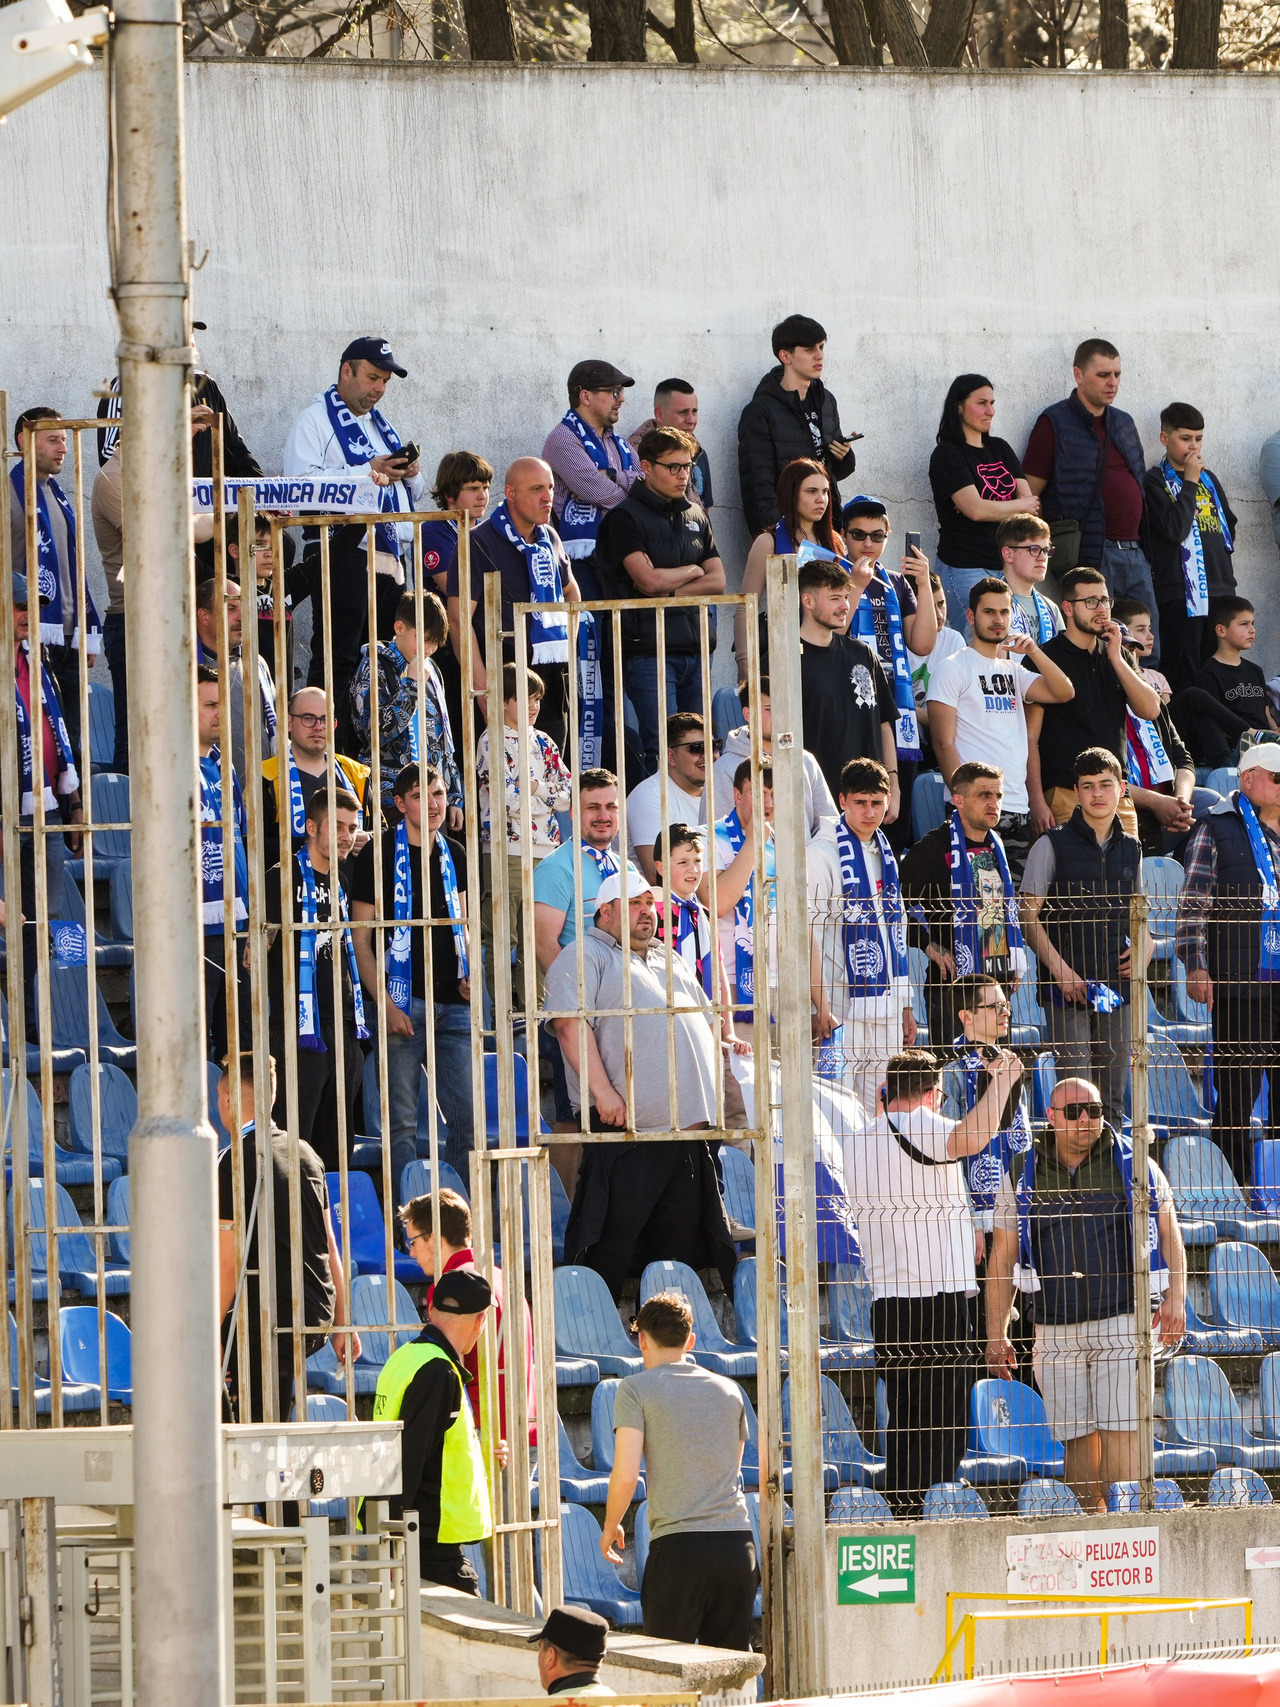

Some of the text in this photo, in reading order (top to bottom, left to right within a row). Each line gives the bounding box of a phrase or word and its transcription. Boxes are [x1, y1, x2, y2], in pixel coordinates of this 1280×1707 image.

[193, 483, 356, 506] OITHNICA IASI
[1225, 683, 1264, 701] adidas
[842, 1543, 911, 1572] IESIRE
[1085, 1539, 1157, 1562] PELUZA SUD
[1090, 1568, 1141, 1588] SECTOR
[1145, 1566, 1154, 1584] B
